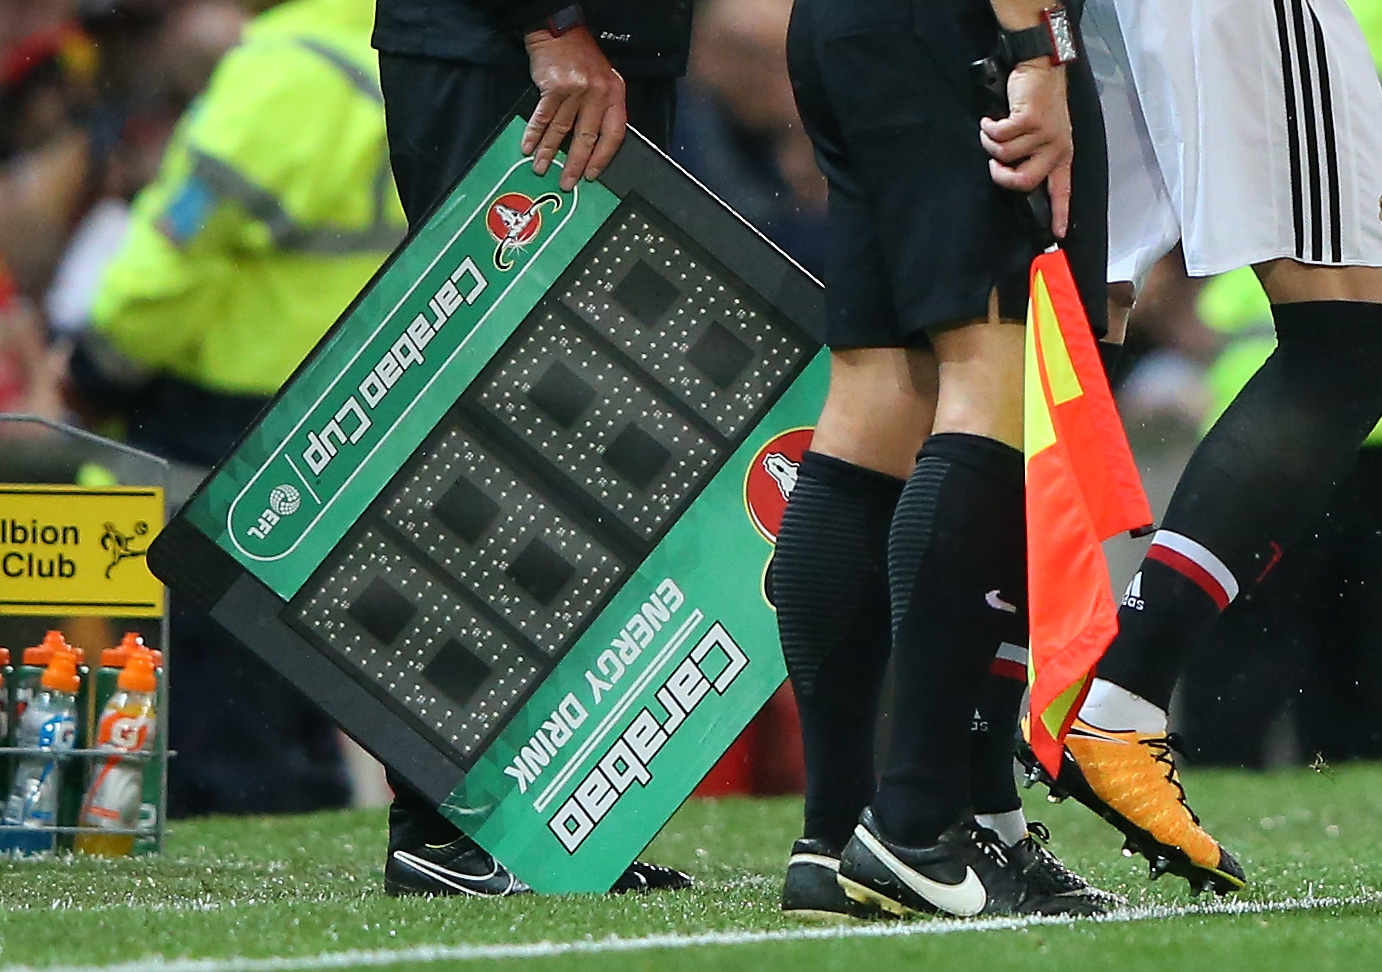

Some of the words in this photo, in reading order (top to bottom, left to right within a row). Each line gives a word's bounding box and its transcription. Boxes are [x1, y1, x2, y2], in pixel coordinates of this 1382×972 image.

[358, 256, 489, 409] Carabao
[302, 395, 373, 476] Cup
[2, 552, 76, 578] Club
[246, 507, 281, 540] EFL
[583, 577, 685, 706] ENERGY
[503, 692, 589, 795] DRINK
[547, 620, 751, 856] Carabao
